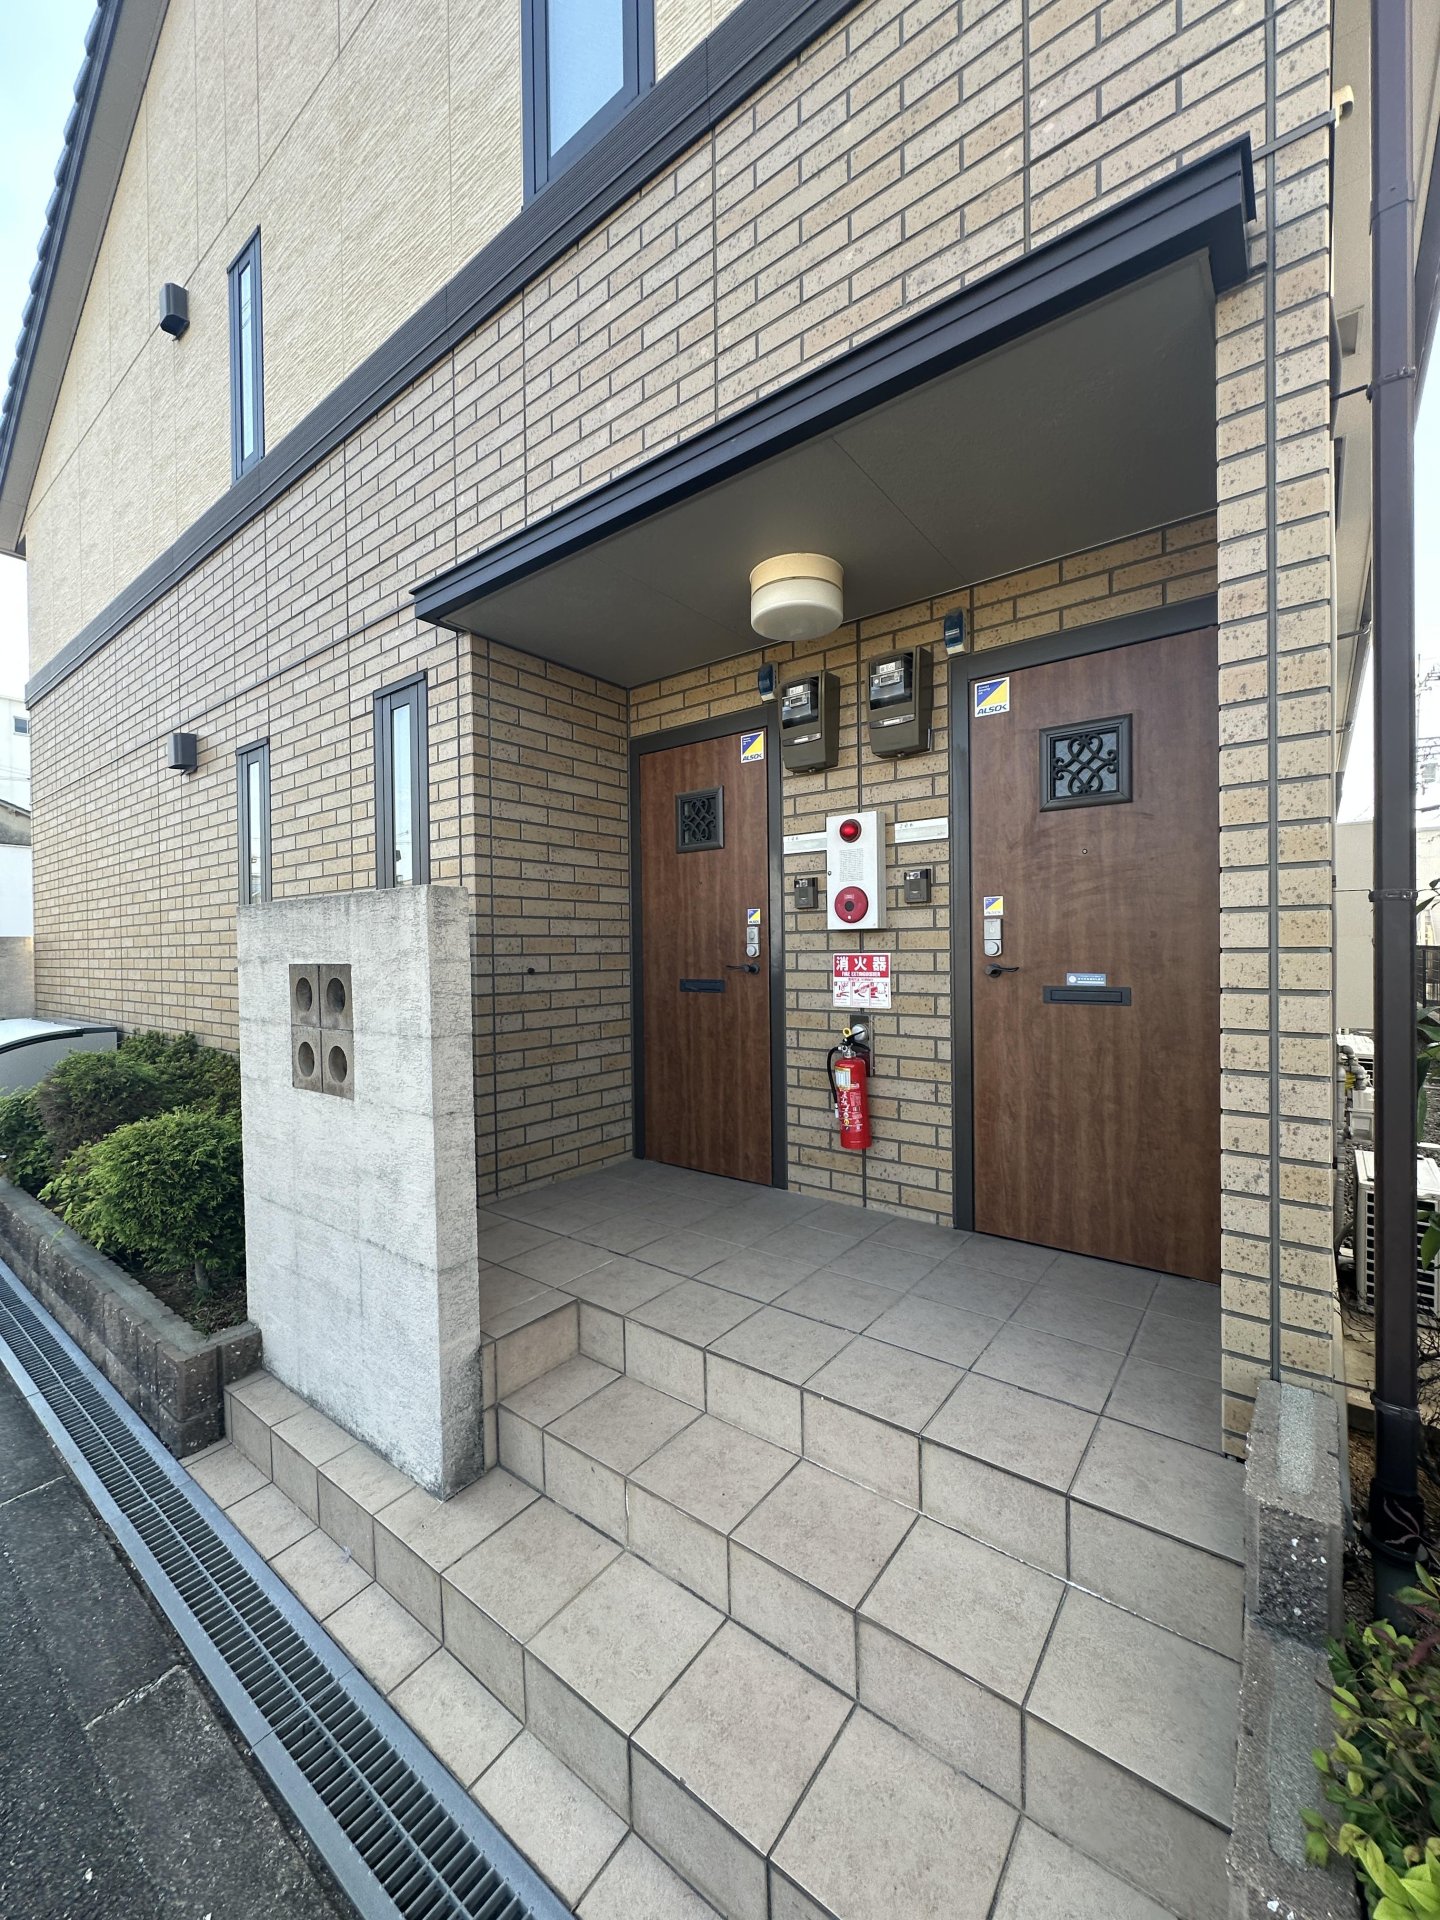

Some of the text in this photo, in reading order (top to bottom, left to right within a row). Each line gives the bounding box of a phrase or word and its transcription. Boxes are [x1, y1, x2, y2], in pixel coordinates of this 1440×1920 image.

[977, 704, 1007, 715] ALSOK
[742, 753, 763, 762] ALSOK
[836, 956, 886, 971] 消火器
